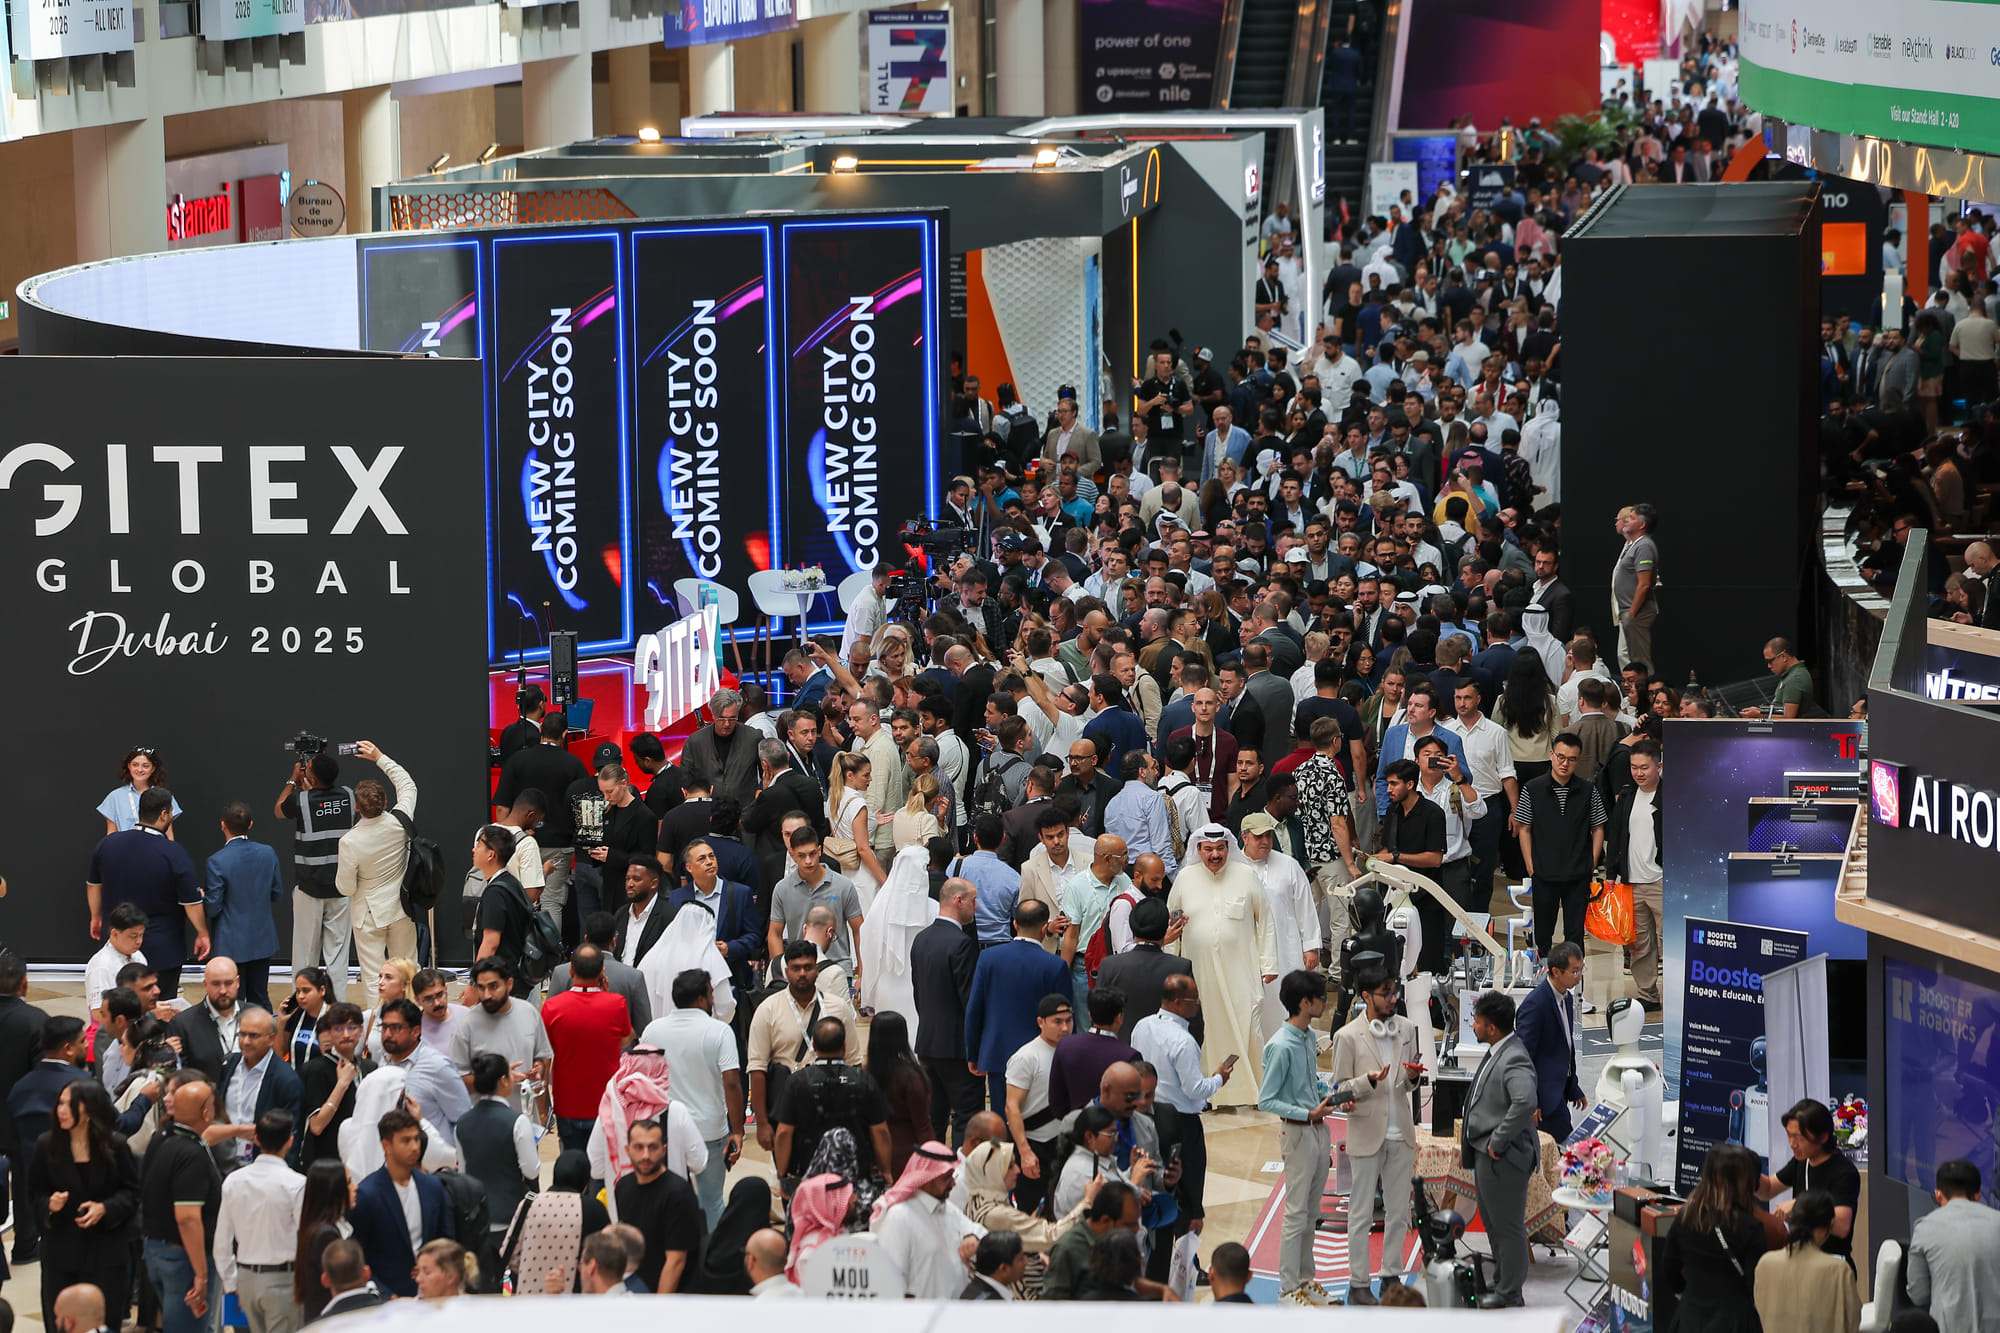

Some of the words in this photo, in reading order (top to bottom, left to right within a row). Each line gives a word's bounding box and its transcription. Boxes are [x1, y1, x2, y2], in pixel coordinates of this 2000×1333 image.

[50, 16, 68, 35] 2026
[235, 2, 250, 19] 2026
[1095, 37, 1139, 51] power
[1144, 33, 1160, 48] of
[1163, 37, 1191, 48] one
[1873, 33, 1891, 50] tenable
[1902, 36, 1933, 62] nexthink
[878, 62, 889, 106] HALL
[890, 29, 947, 111] 7
[1160, 85, 1191, 101] nile
[1890, 105, 1901, 121] Visit
[1902, 111, 1911, 122] our
[1929, 109, 1939, 126] Hall
[299, 196, 332, 206] Bureau
[309, 207, 320, 215] de
[298, 217, 333, 227] Change
[550, 307, 574, 419] SOON
[693, 300, 718, 409] SOON
[850, 296, 876, 404] SOON
[528, 360, 550, 446] CITY
[668, 350, 693, 436] CITY
[823, 346, 848, 430] CITY
[0, 443, 410, 537] GITEX
[670, 447, 694, 540] NEW
[696, 422, 721, 578] COMING
[825, 441, 850, 533] NEW
[852, 416, 880, 571] COMING
[530, 459, 553, 552] NEW
[553, 431, 578, 590] COMING
[36, 558, 410, 594] GLOBAL
[67, 610, 229, 676] Dubai
[250, 627, 365, 654] 2025
[634, 603, 721, 732] GITEX
[316, 807, 341, 817] ORD
[323, 799, 349, 808] REC
[1909, 776, 1940, 834] AI
[1707, 930, 1736, 941] BOOSTER
[1707, 938, 1737, 949] ROBOTICS
[1691, 959, 1764, 991] Booste
[1919, 986, 1973, 1019] BOOSTER
[1689, 1021, 1701, 1030] Voice
[1702, 1023, 1720, 1033] Module
[1919, 1009, 1976, 1044] ROBOTICS
[1688, 1044, 1702, 1053] Vision
[1703, 1047, 1721, 1056] Module
[1686, 1078, 1690, 1087] 2
[1684, 1125, 1694, 1134] GPU
[833, 1267, 869, 1289] MOU
[1620, 1287, 1648, 1322] ROBOT
